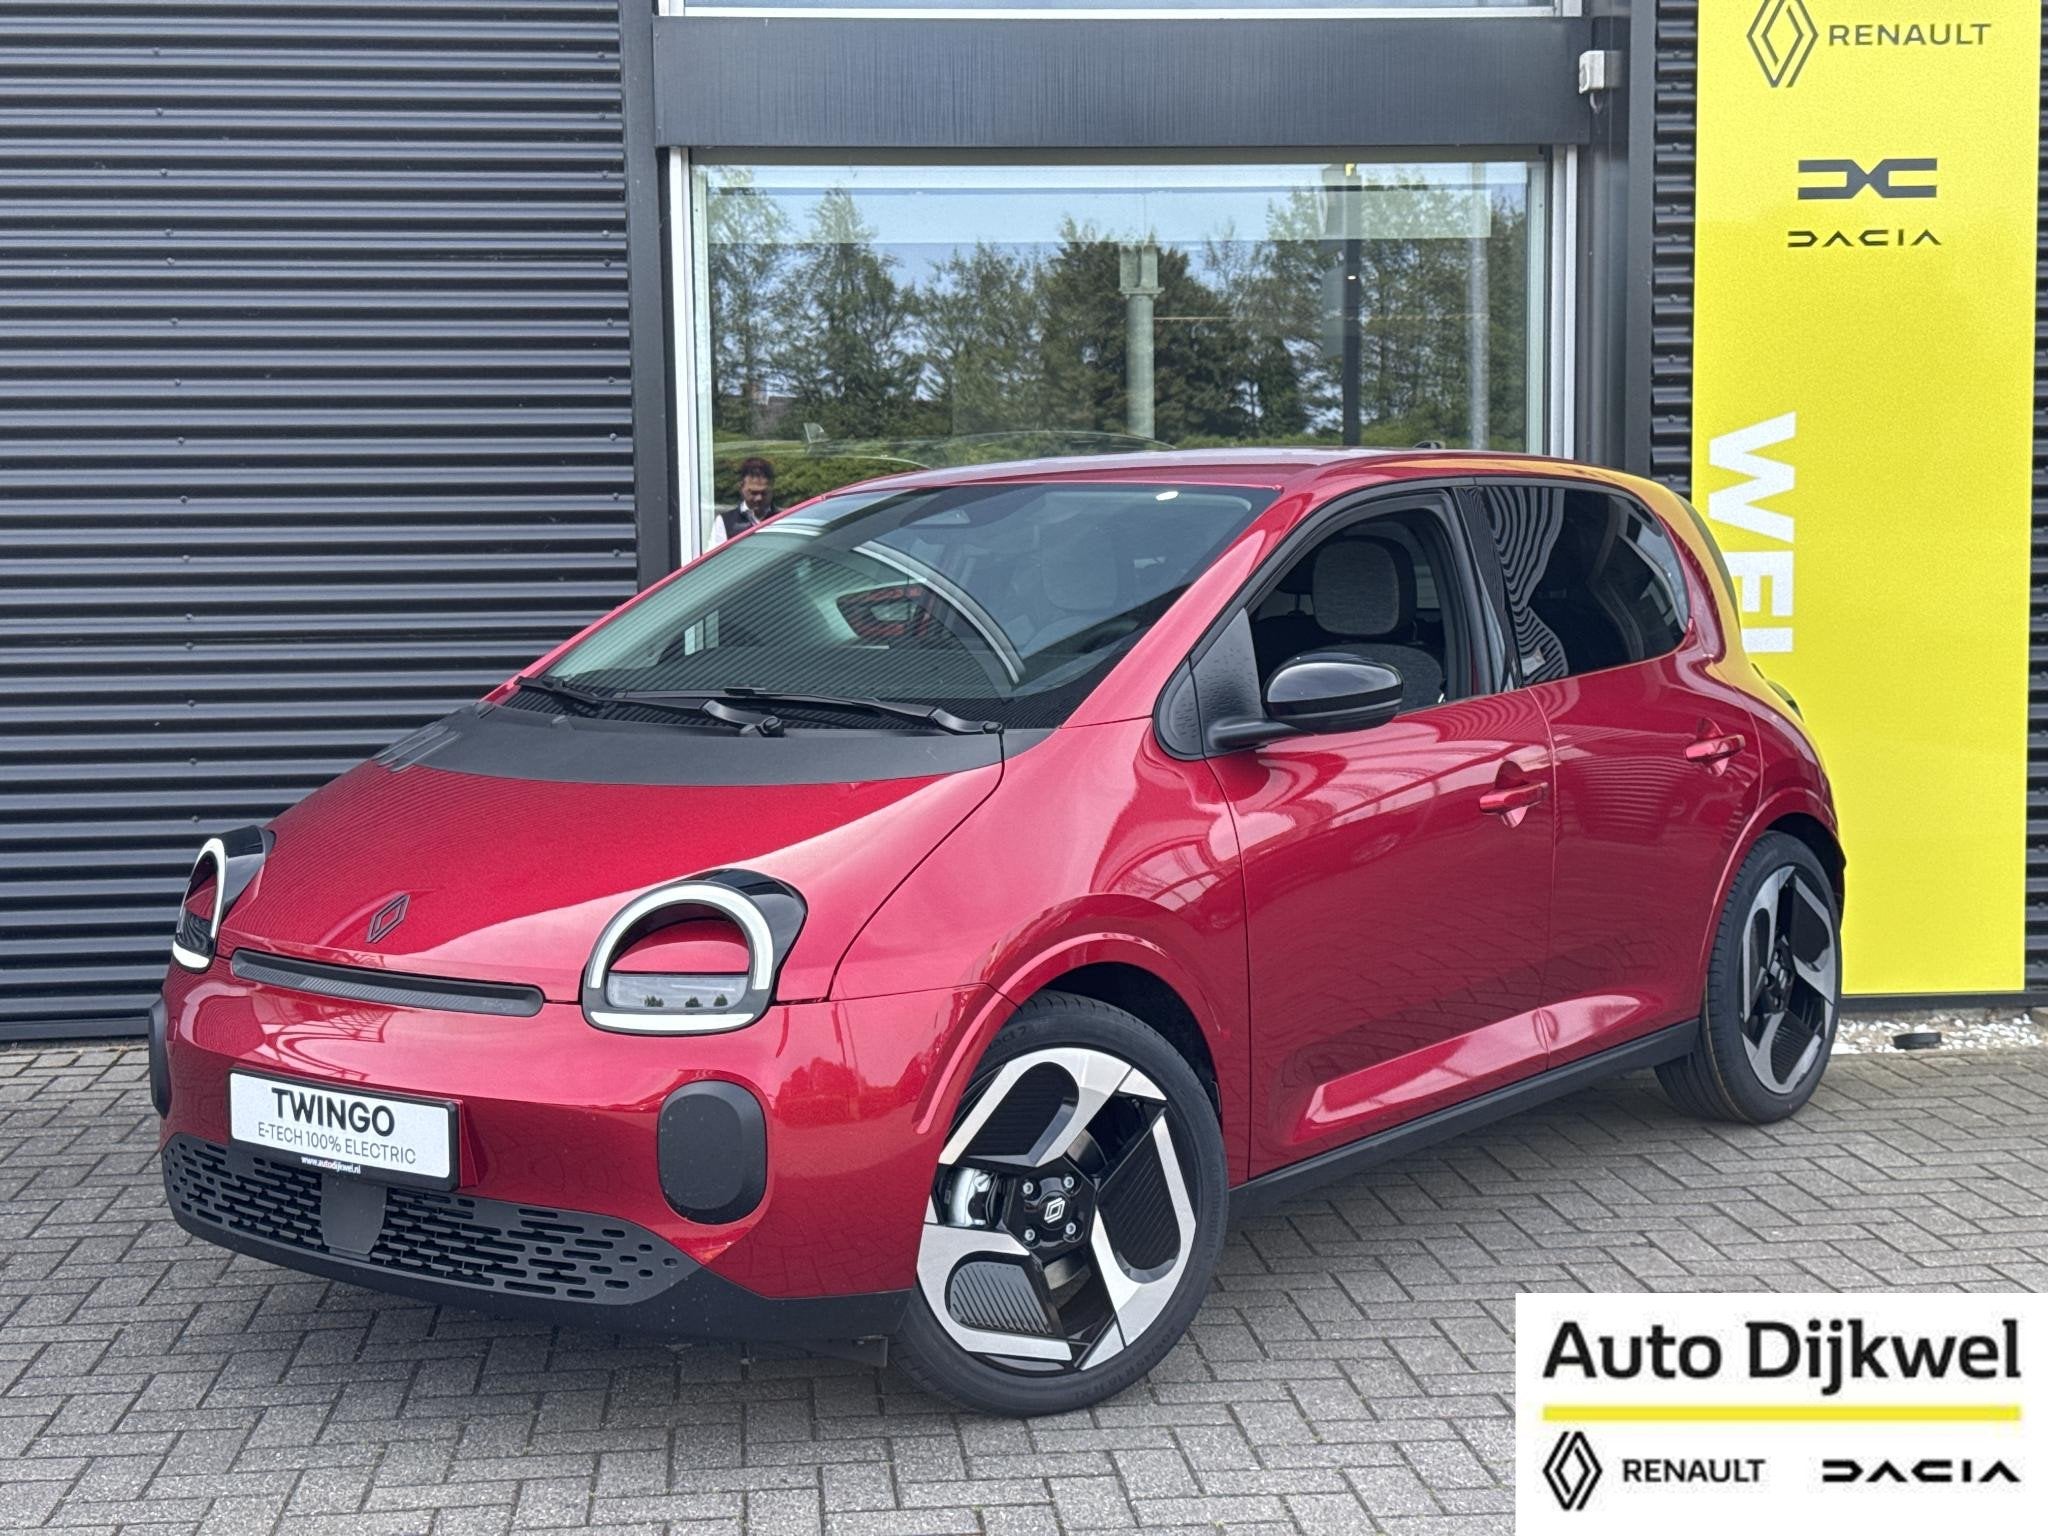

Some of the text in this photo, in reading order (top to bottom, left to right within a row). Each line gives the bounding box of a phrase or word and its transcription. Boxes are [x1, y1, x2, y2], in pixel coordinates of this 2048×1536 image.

[1828, 23, 1992, 46] RENAULT
[1787, 229, 1942, 248] DACIA
[271, 1087, 395, 1137] TWINGO
[258, 1121, 416, 1164] E-TECH 100% ELECTRIC
